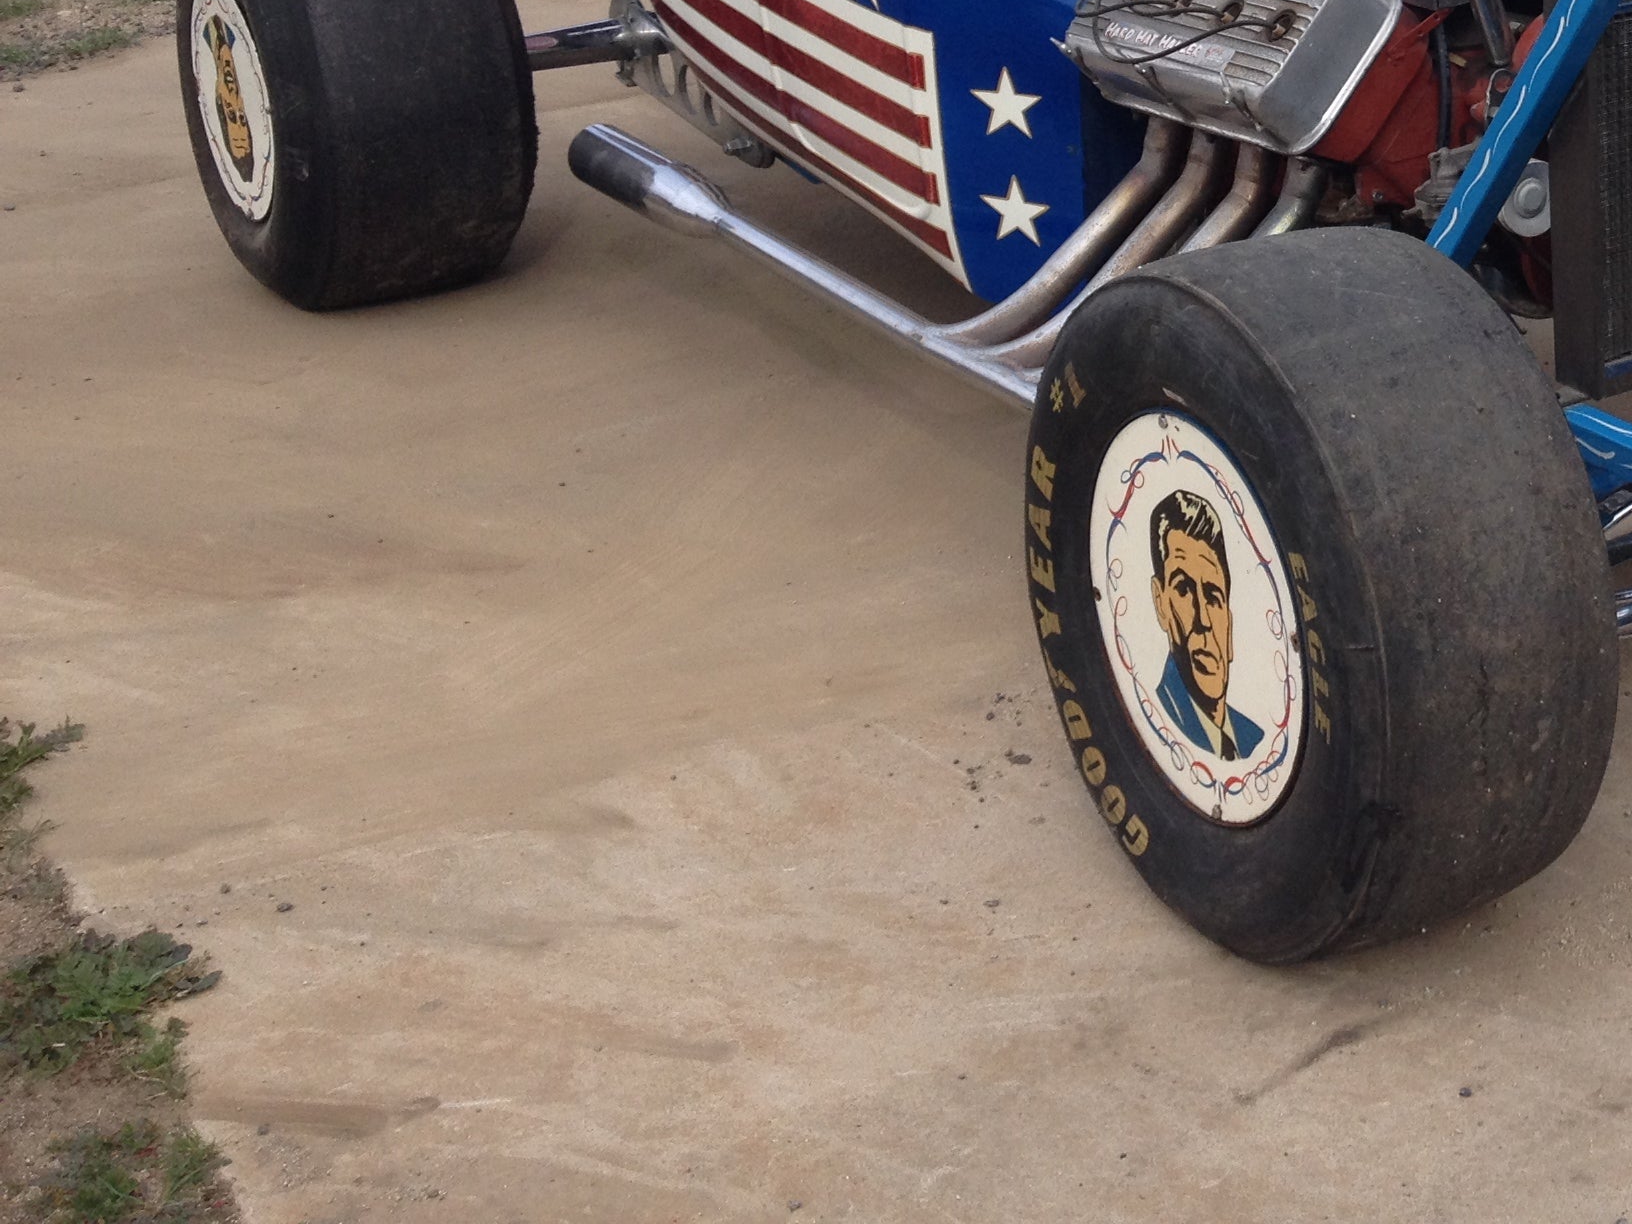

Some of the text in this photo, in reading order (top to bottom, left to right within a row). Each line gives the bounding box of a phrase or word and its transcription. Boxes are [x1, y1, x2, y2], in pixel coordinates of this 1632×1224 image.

[1104, 21, 1135, 40] HARD
[1135, 29, 1159, 46] HAT
[1027, 444, 1149, 857] GOODYEAR
[1288, 551, 1331, 745] EAGLE
